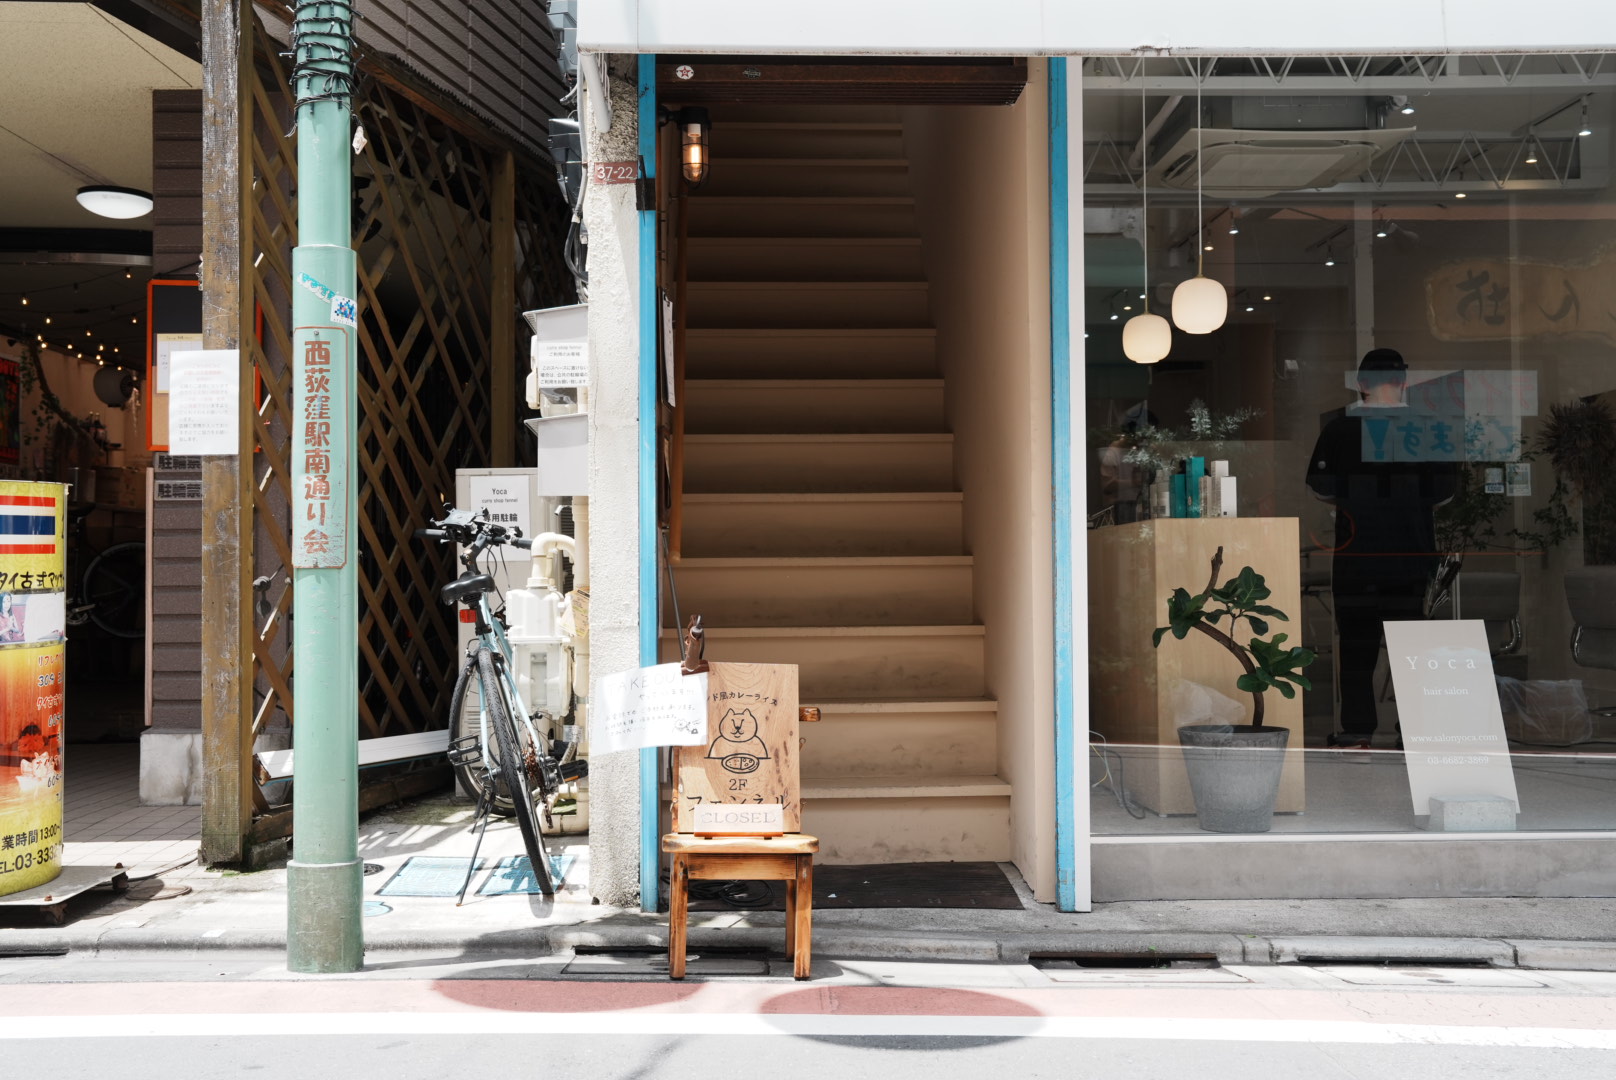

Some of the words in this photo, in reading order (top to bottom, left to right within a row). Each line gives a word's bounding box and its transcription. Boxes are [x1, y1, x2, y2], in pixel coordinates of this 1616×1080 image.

[597, 166, 634, 179] 37-22
[303, 340, 331, 554] 西荻窪駅南通り会
[1406, 656, 1477, 670] Yoca
[1423, 687, 1442, 695] hair
[1444, 687, 1469, 695] salon
[1410, 733, 1498, 744] www.salonyoca.com
[729, 778, 748, 791] 2F
[1, 829, 38, 851] 業時間
